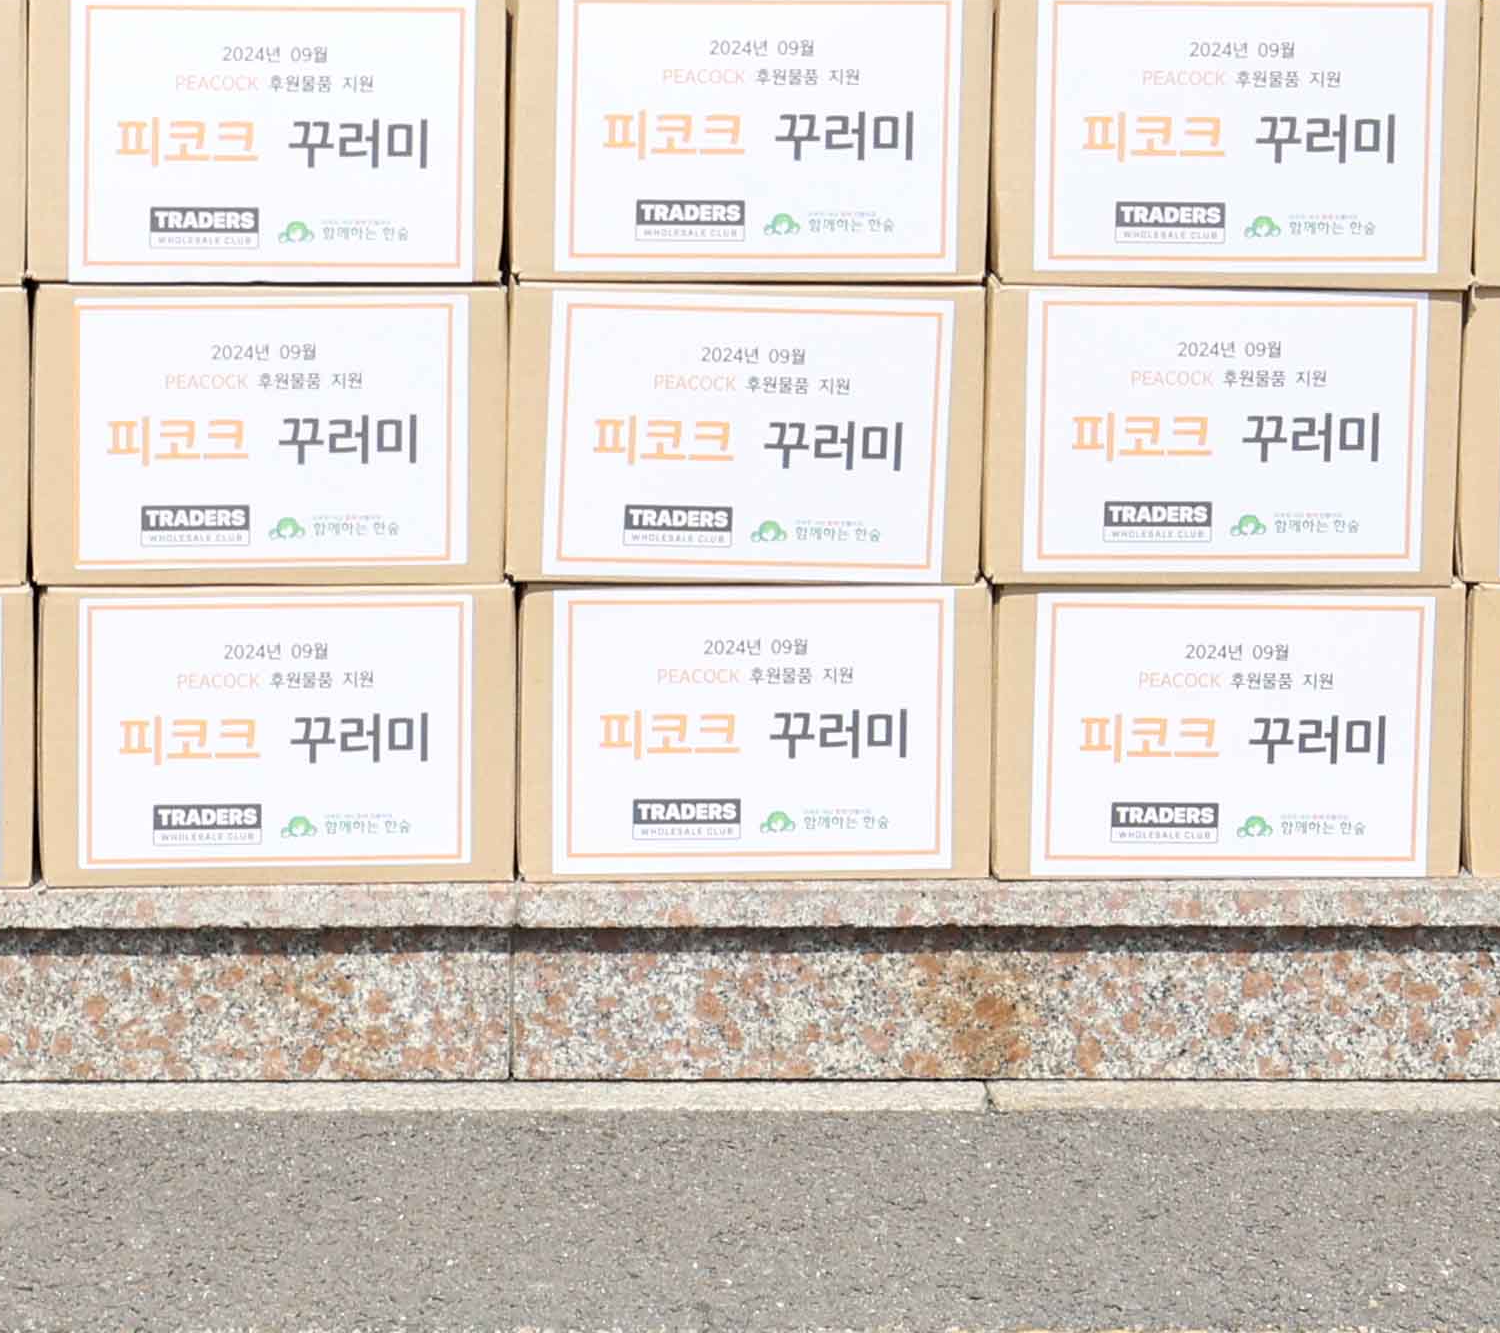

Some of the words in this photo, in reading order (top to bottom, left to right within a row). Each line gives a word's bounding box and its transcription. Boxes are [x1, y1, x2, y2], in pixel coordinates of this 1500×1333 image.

[704, 638, 761, 658] 2024년
[771, 637, 810, 657] 09월
[656, 667, 740, 685] PEACOCK
[750, 665, 813, 686] 후원물품
[822, 664, 855, 685] 지원
[599, 711, 740, 759] 피코크
[769, 708, 909, 760] 꾸러미
[636, 802, 738, 822] TRADERS
